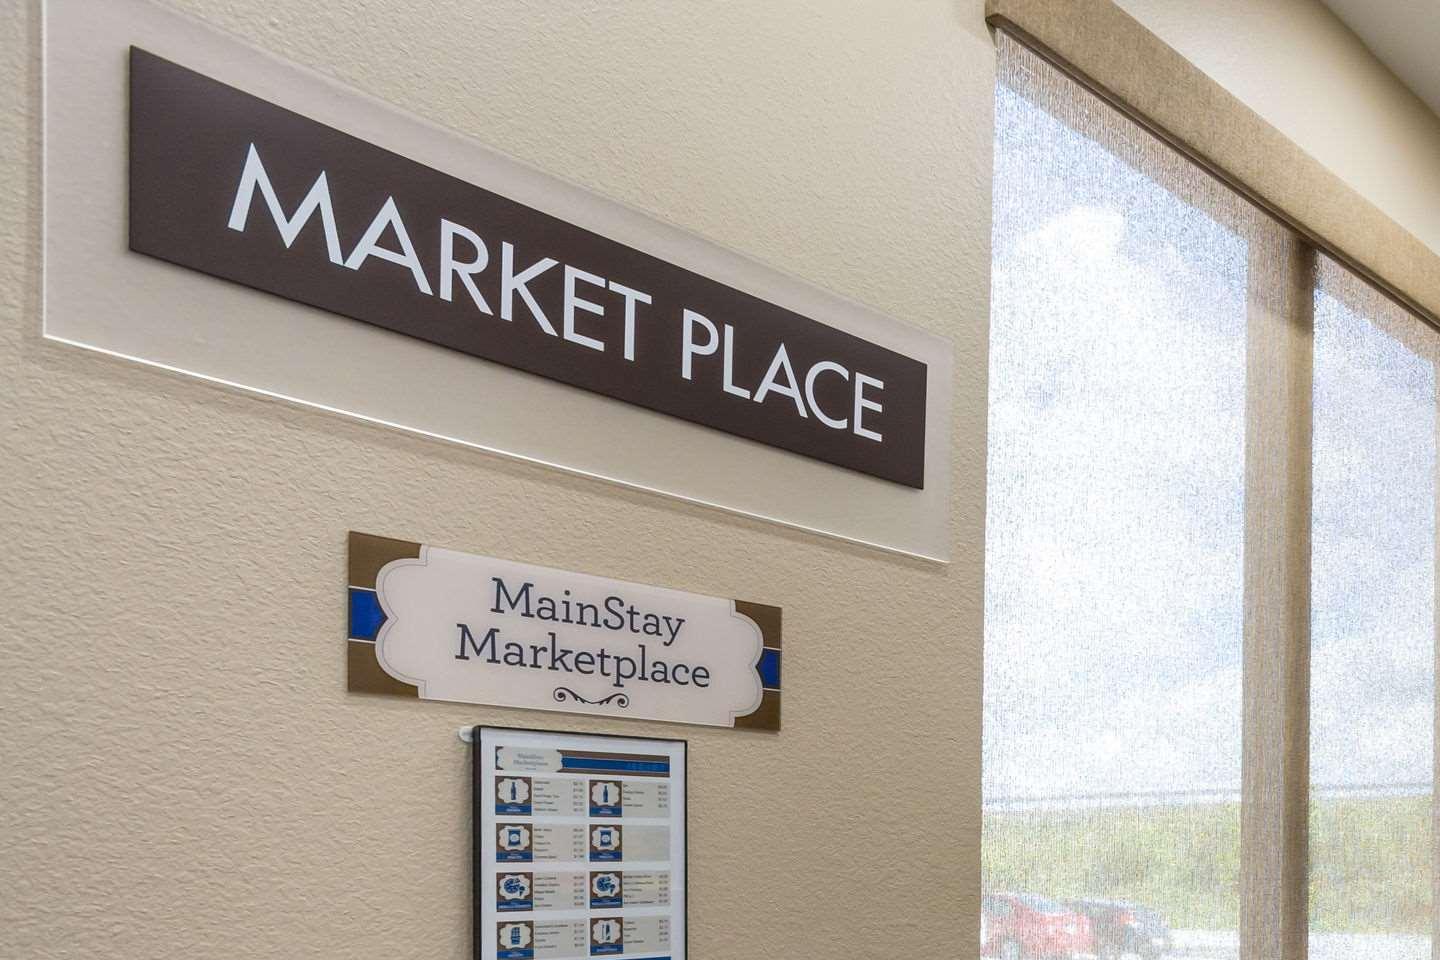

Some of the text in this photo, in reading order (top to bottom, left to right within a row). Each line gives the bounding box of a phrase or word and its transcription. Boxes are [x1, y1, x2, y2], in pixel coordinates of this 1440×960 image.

[227, 142, 884, 442] MARKET PLACE
[490, 577, 686, 647] MainStay
[454, 623, 710, 688] Marketplace
